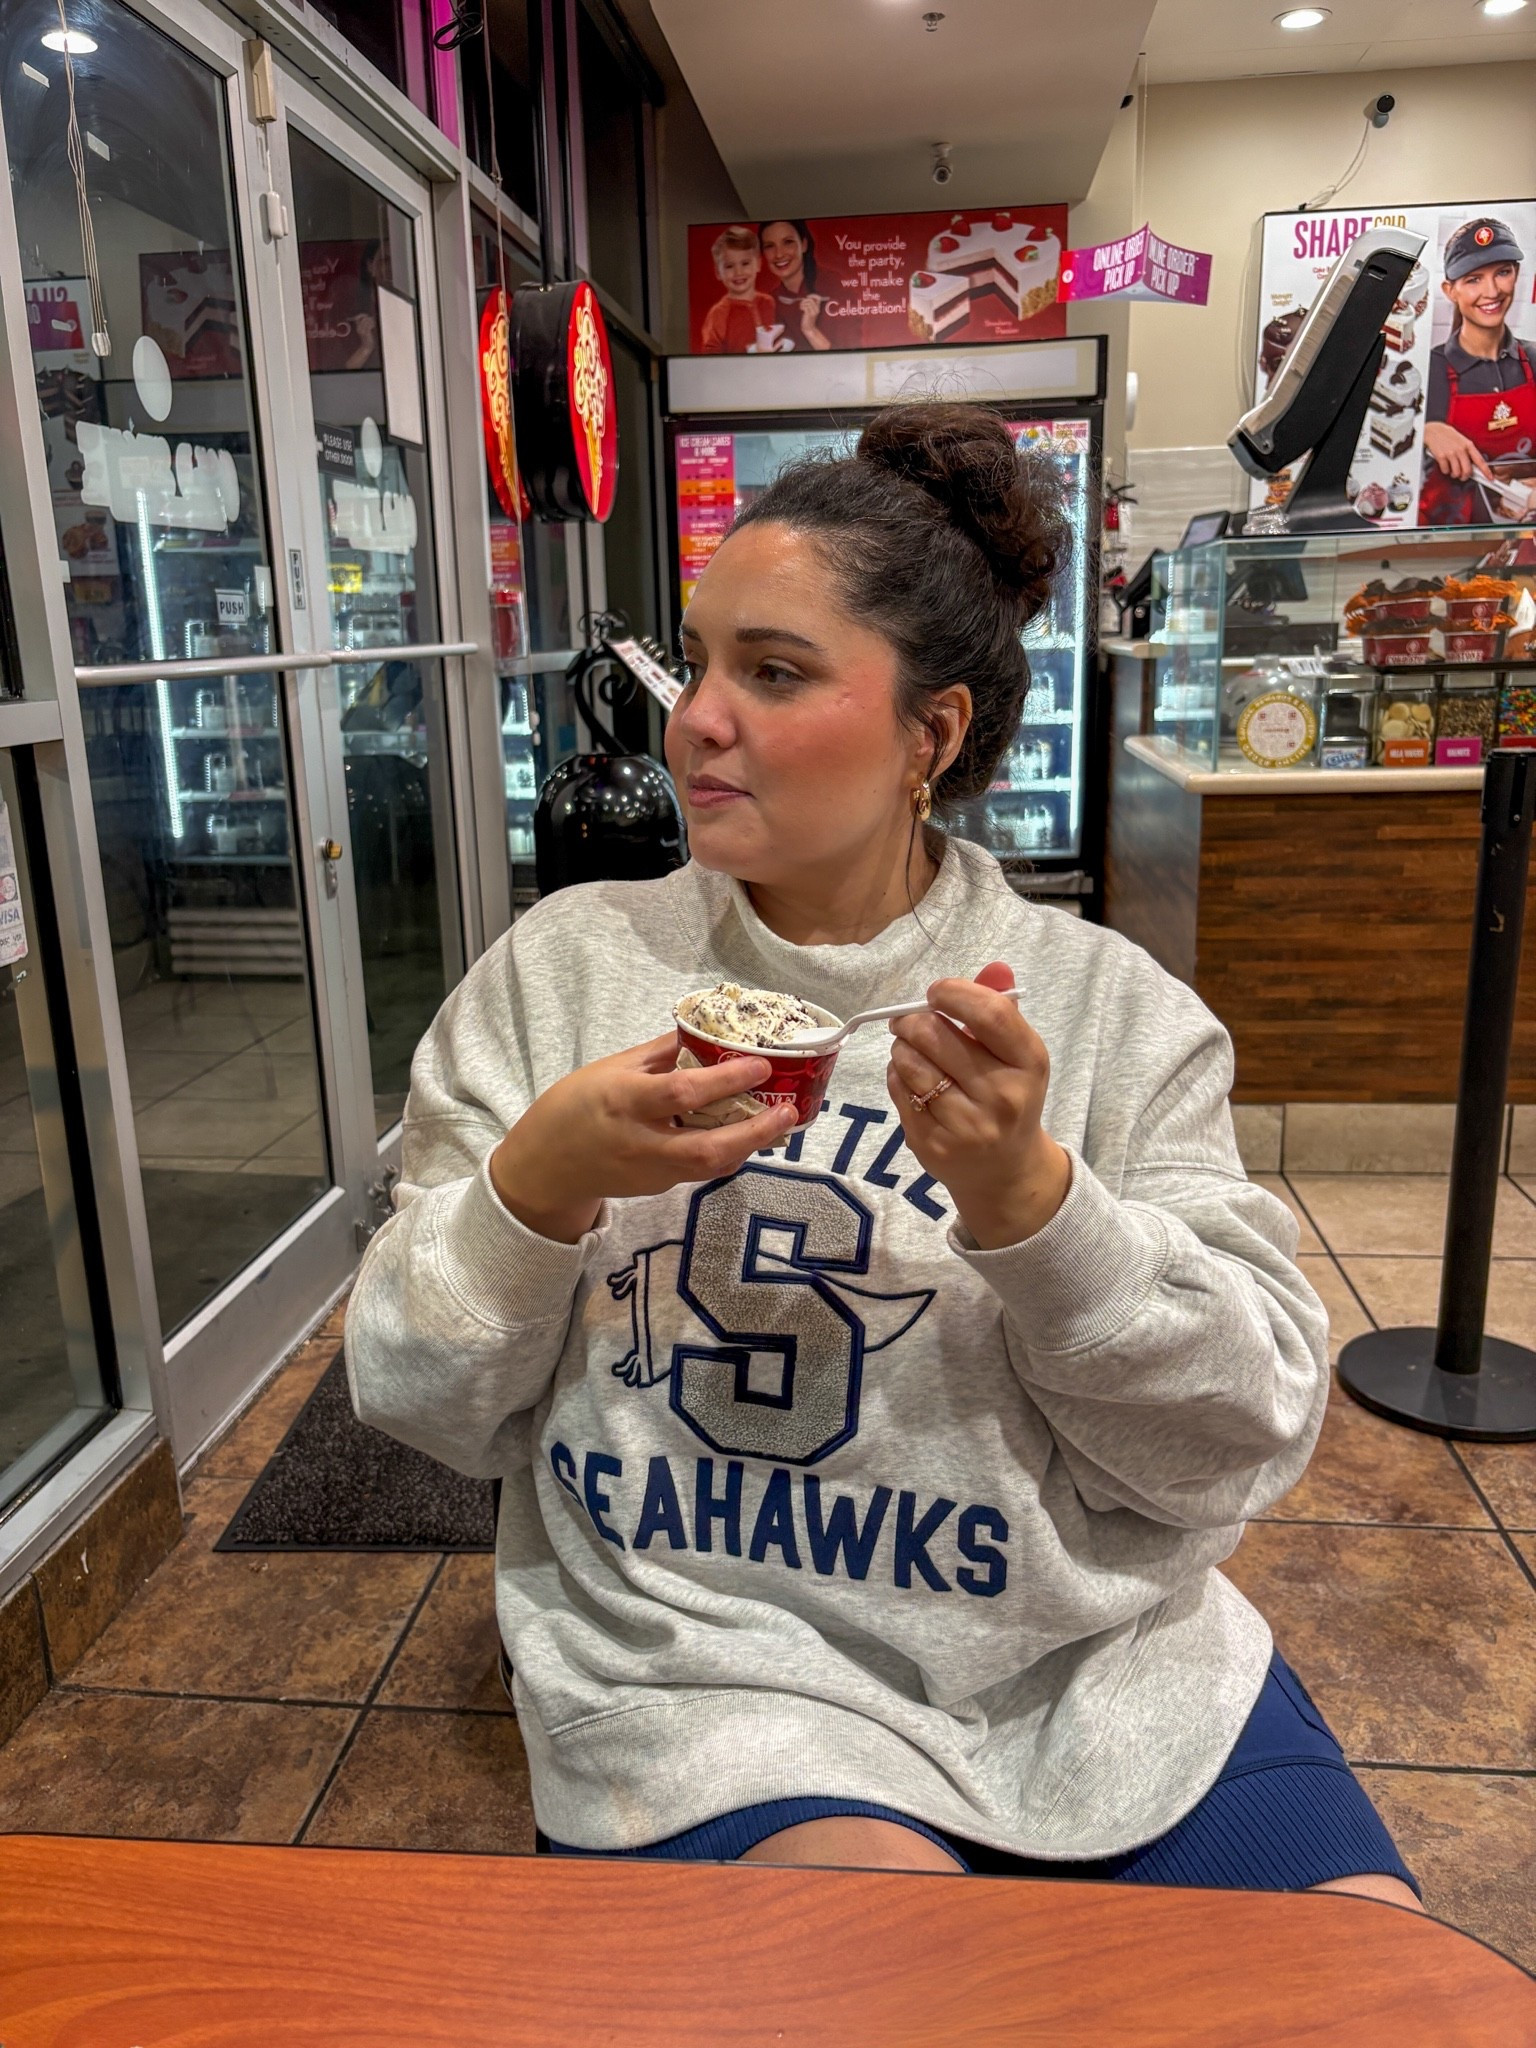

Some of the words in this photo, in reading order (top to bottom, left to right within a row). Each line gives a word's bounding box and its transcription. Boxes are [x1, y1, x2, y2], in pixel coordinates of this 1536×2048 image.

[835, 235, 862, 251] You
[863, 235, 907, 255] provide
[1093, 241, 1125, 271] ONLINE
[848, 253, 866, 268] the
[1167, 247, 1195, 276] ORDER
[841, 272, 868, 287] we'll
[869, 271, 904, 287] make
[1103, 264, 1125, 292] PICK
[1124, 260, 1136, 286] UP
[1151, 264, 1168, 293] PICK
[1167, 271, 1180, 296] UP
[863, 288, 880, 301] the
[825, 298, 906, 317] Celebration!
[293, 553, 303, 606] PUSH
[220, 601, 244, 616] PUSH
[550, 1440, 1008, 1597] SEAHAWKS
